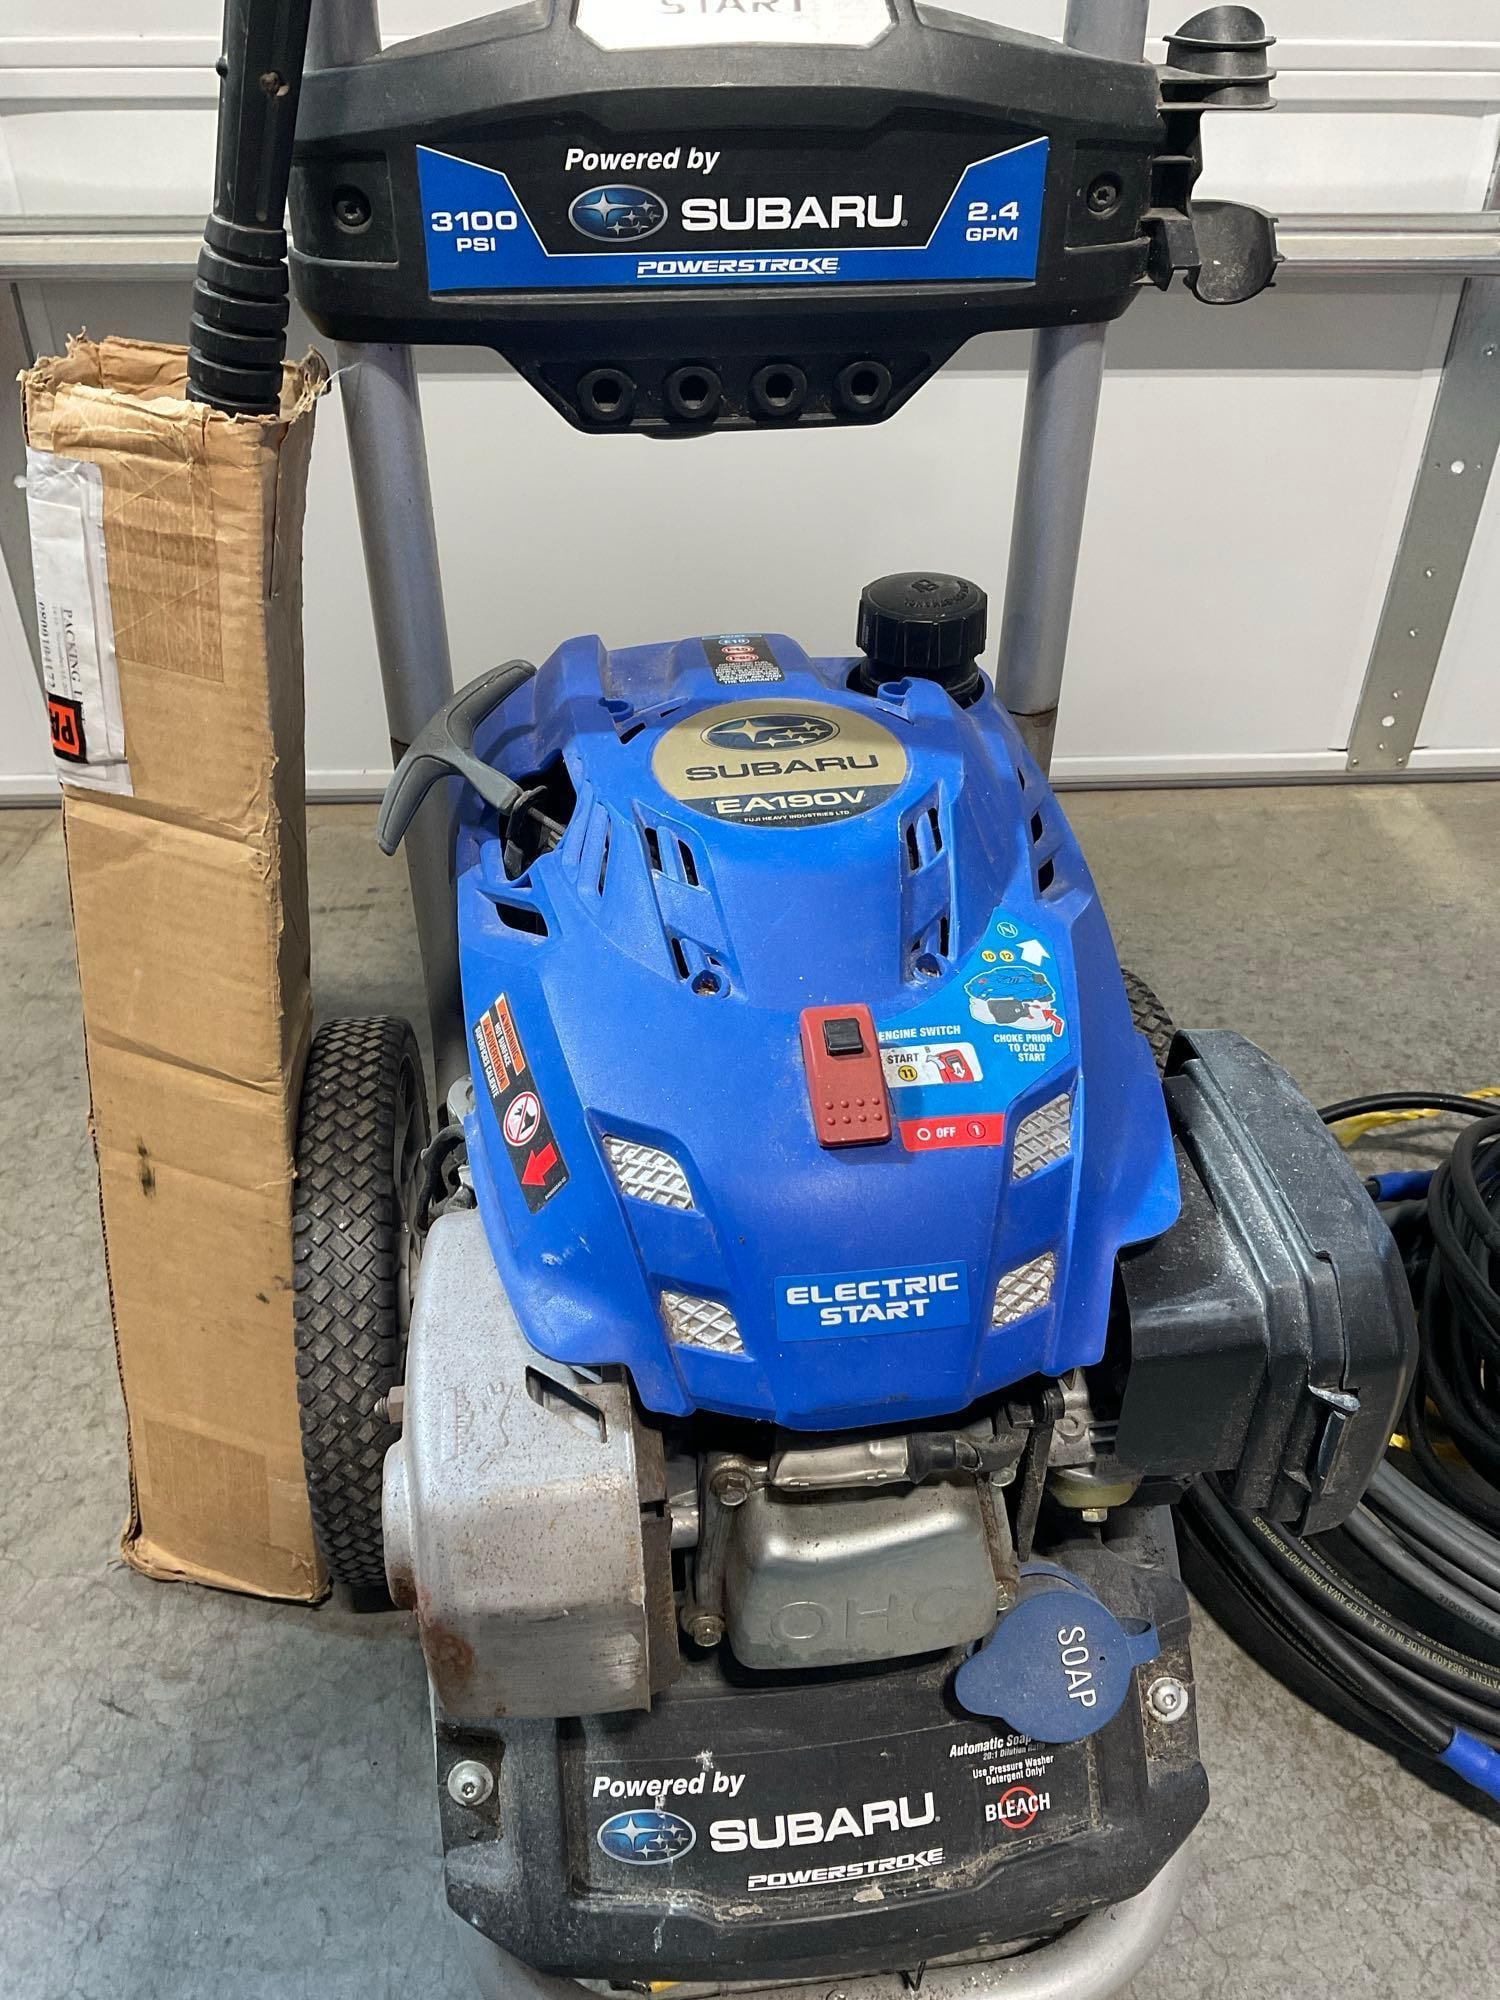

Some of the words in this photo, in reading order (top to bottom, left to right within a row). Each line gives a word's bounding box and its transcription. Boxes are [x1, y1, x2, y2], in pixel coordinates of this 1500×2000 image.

[564, 148, 681, 172] Powered
[687, 148, 720, 175] by
[431, 210, 518, 232] 3100
[681, 195, 904, 231] SUBARU
[966, 202, 1020, 222] 2.4
[456, 237, 497, 253] PSI
[965, 227, 1019, 242] GPM
[636, 257, 840, 276] POWERSTROKE
[63, 608, 81, 683] PACKING
[685, 754, 880, 781] SUBARU
[715, 790, 865, 815] EA190V
[789, 811, 831, 820] INDUSTRIES
[983, 952, 995, 960] 10
[1000, 952, 1013, 960] 12
[494, 1022, 503, 1038] HOT
[878, 1028, 917, 1040] ENGINE
[919, 1025, 961, 1037] SWITCH
[993, 1033, 1024, 1044] CHOKE
[1026, 1033, 1053, 1043] PRIOR
[503, 1022, 519, 1060] WARNING
[1009, 1043, 1021, 1052] TO
[1023, 1043, 1045, 1053] COLD
[485, 1030, 505, 1086] ADVERTENCIA
[498, 1036, 511, 1068] SURFACE
[887, 1053, 919, 1064] START
[1018, 1053, 1046, 1062] START
[485, 1065, 500, 1099] CALIENTE
[901, 1069, 914, 1079] 11
[936, 1127, 956, 1138] OFF
[786, 1272, 960, 1305] ELECTRIC
[820, 1298, 930, 1326] START
[1252, 1516, 1289, 1553] SURFACES
[1285, 1551, 1301, 1567] HOT
[1300, 1564, 1323, 1585] FROM
[1322, 1582, 1348, 1602] AWAY
[770, 1588, 967, 1641] OHC
[1346, 1602, 1369, 1620] KEEP
[1396, 1632, 1406, 1644] IN
[1406, 1638, 1430, 1657] MADE
[1057, 1624, 1097, 1710] SOAP
[1432, 1652, 1469, 1675] 5964409
[949, 1736, 1004, 1758] Automatic
[1006, 1733, 1032, 1746] Soap
[982, 1751, 998, 1761] 20:1
[1000, 1747, 1026, 1758] Dilution
[972, 1768, 987, 1779] Use
[989, 1761, 1023, 1775] Pressure
[1025, 1755, 1054, 1768] Washer
[985, 1773, 1023, 1786] Detergent
[1026, 1765, 1046, 1778] Only!
[592, 1774, 704, 1799] Powered
[712, 1772, 745, 1798] by
[985, 1792, 1051, 1822] BLEACH
[709, 1792, 935, 1853] SUBARU
[748, 1847, 944, 1887] POWERSTROKE
